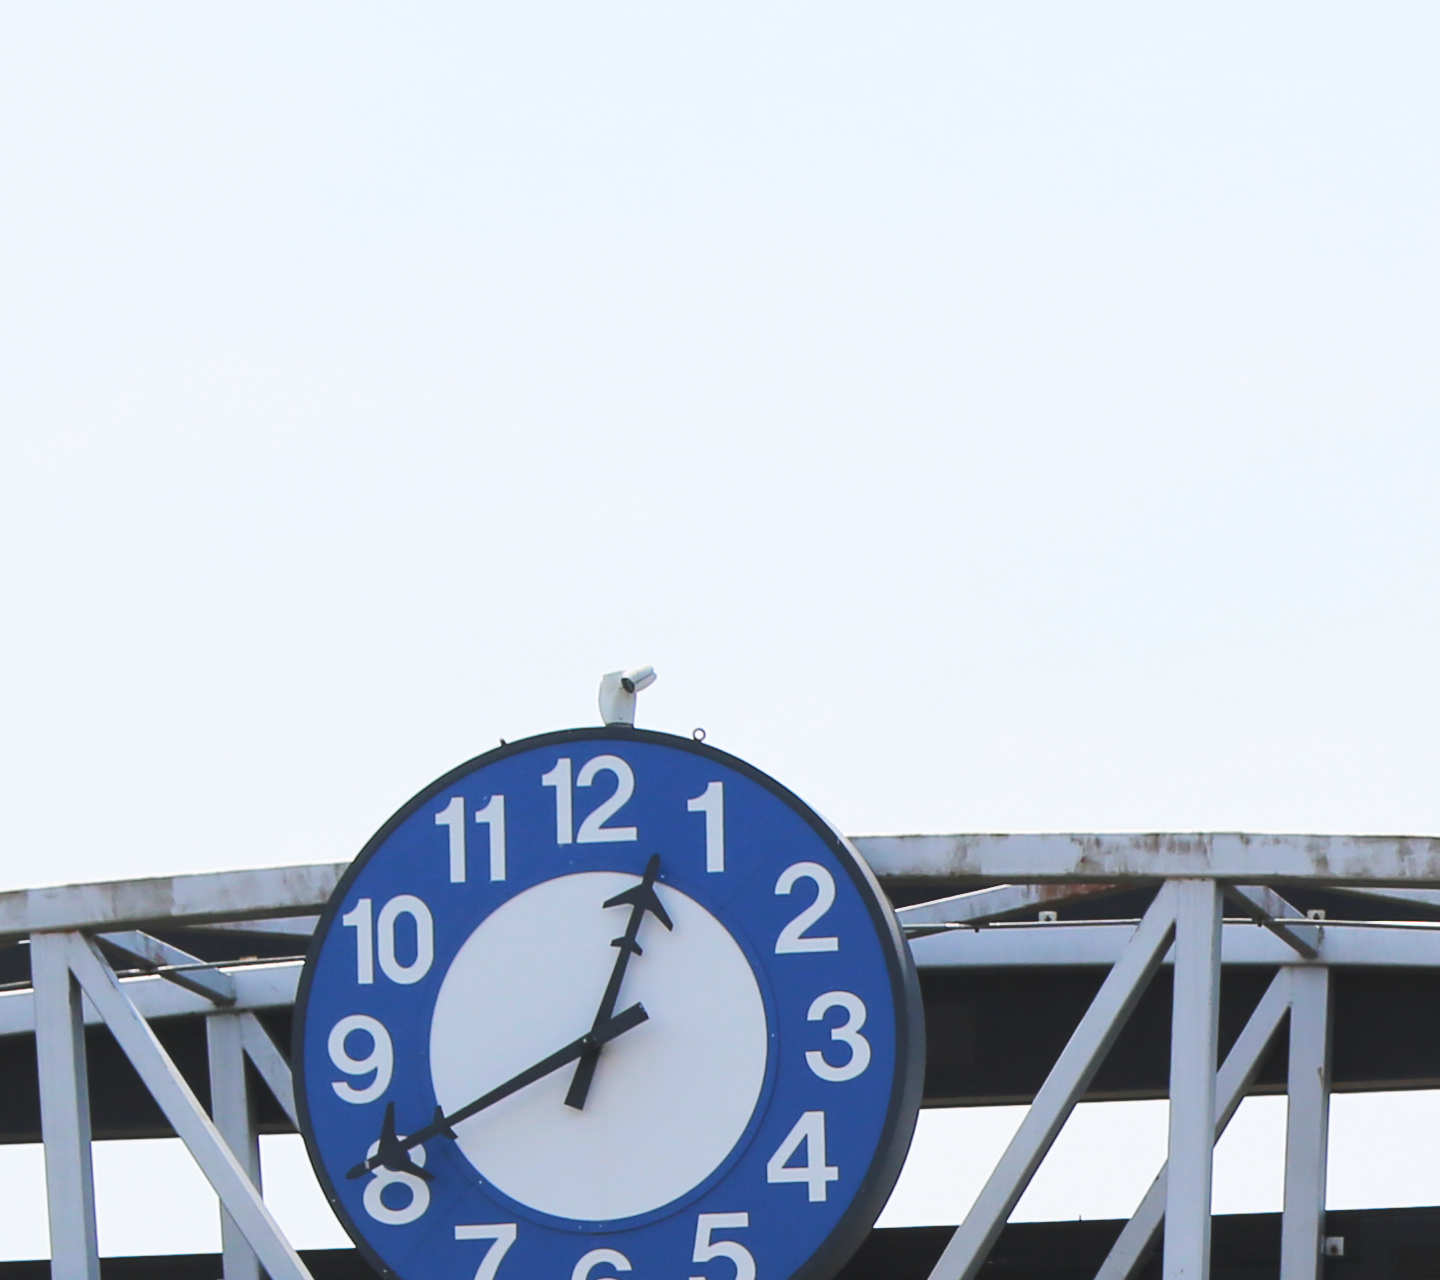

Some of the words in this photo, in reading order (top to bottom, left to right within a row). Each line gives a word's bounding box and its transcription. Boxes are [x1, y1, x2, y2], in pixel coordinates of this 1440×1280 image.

[435, 794, 506, 883] 11
[541, 754, 637, 845] 12
[687, 781, 725, 873] 1
[342, 894, 434, 985] 10
[774, 861, 839, 954] 2
[328, 1014, 394, 1104] 9
[805, 991, 871, 1082] 3
[363, 1134, 430, 1225] 8
[766, 1111, 839, 1202] 4
